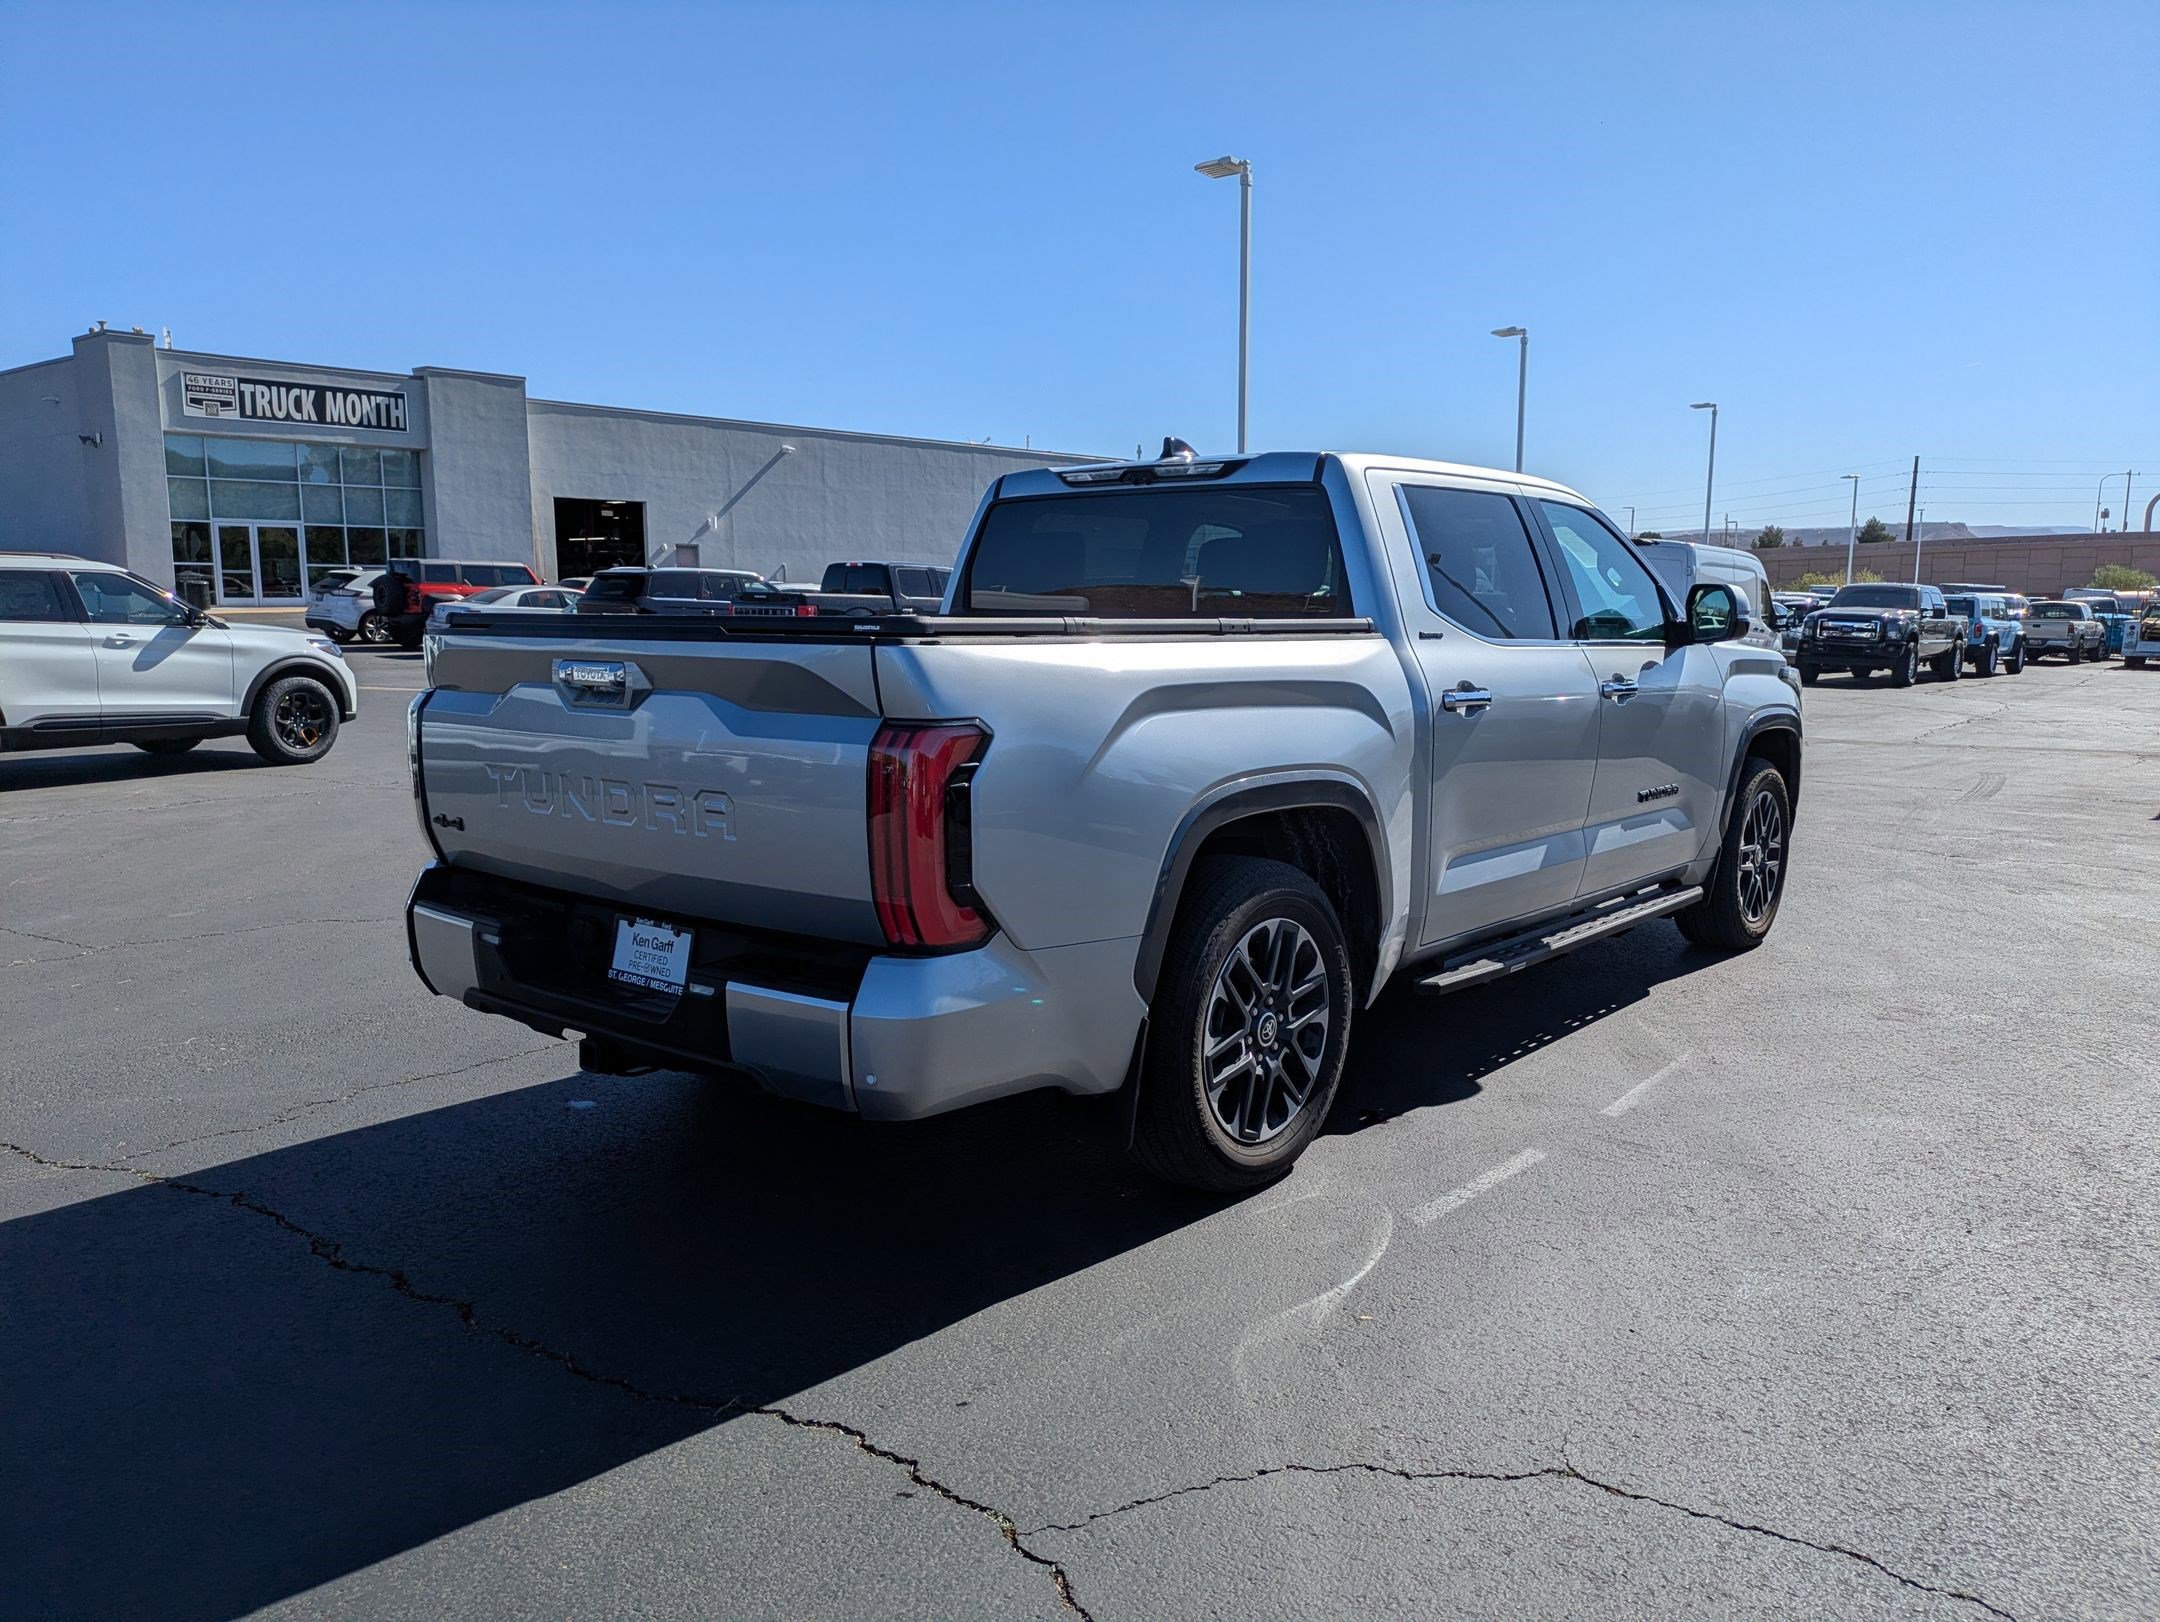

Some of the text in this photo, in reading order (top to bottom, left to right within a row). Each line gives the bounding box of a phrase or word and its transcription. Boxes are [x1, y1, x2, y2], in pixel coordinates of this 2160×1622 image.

[188, 376, 233, 388] 46 YEARS
[239, 382, 406, 429] TRUCK MONTH
[574, 667, 608, 680] TOYOTA
[484, 762, 738, 841] TUNDRA
[631, 931, 675, 954] Ken Garff
[628, 959, 671, 978] PRE-OWNED
[633, 950, 669, 966] CERTIFIED
[608, 969, 618, 979] ST.
[618, 971, 646, 986] GEORGE
[650, 979, 684, 996] MESQUITE
